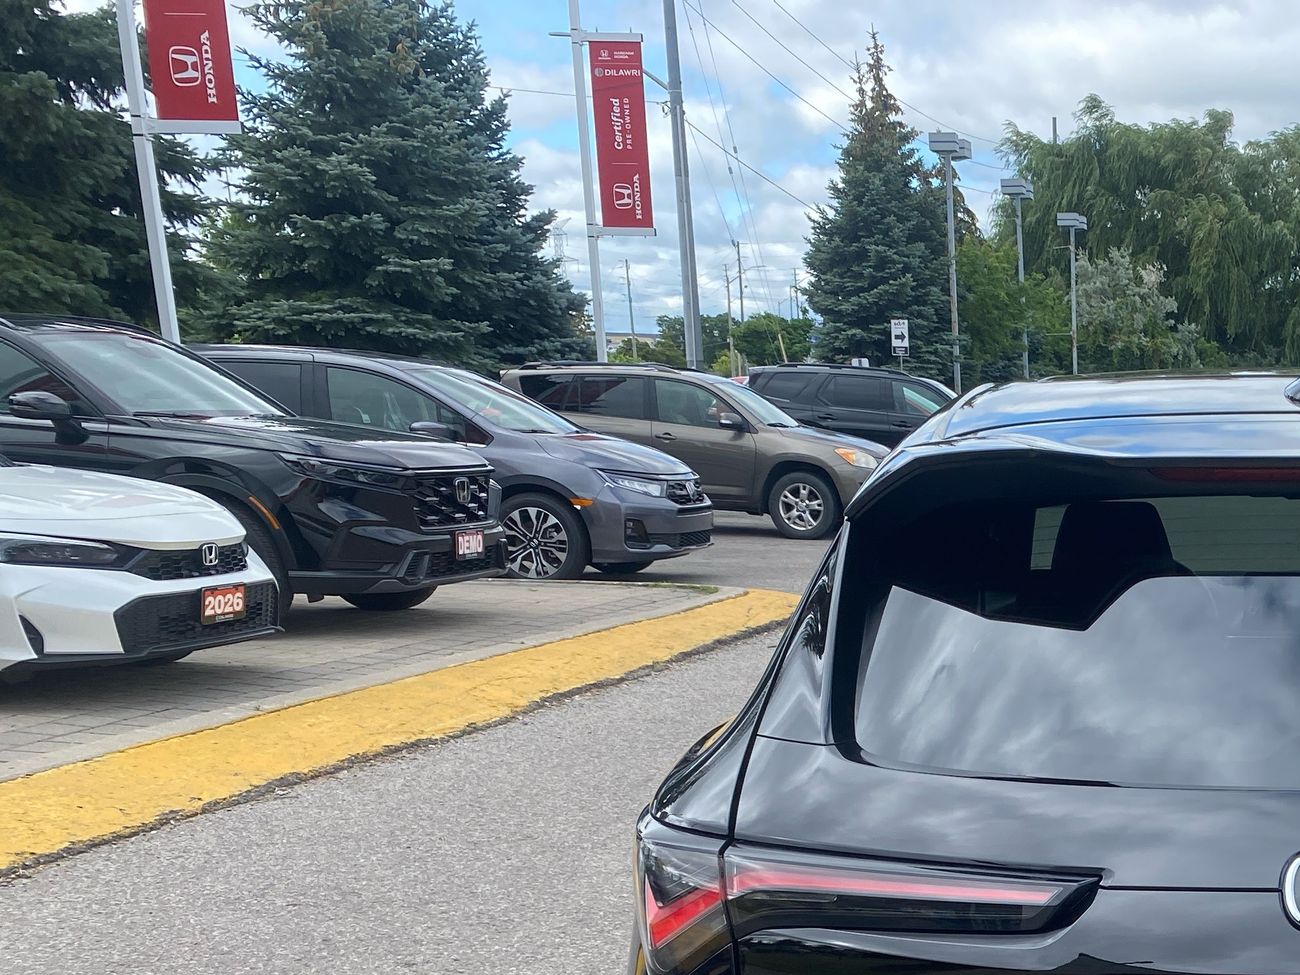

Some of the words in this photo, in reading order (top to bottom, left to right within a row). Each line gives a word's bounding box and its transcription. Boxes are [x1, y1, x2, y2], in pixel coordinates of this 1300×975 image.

[200, 30, 217, 104] HONDA
[610, 98, 624, 150] Certified
[623, 97, 633, 150] PRE-OWNED
[633, 173, 643, 220] HONDA
[458, 535, 483, 555] DEMO
[204, 592, 243, 617] 2026
